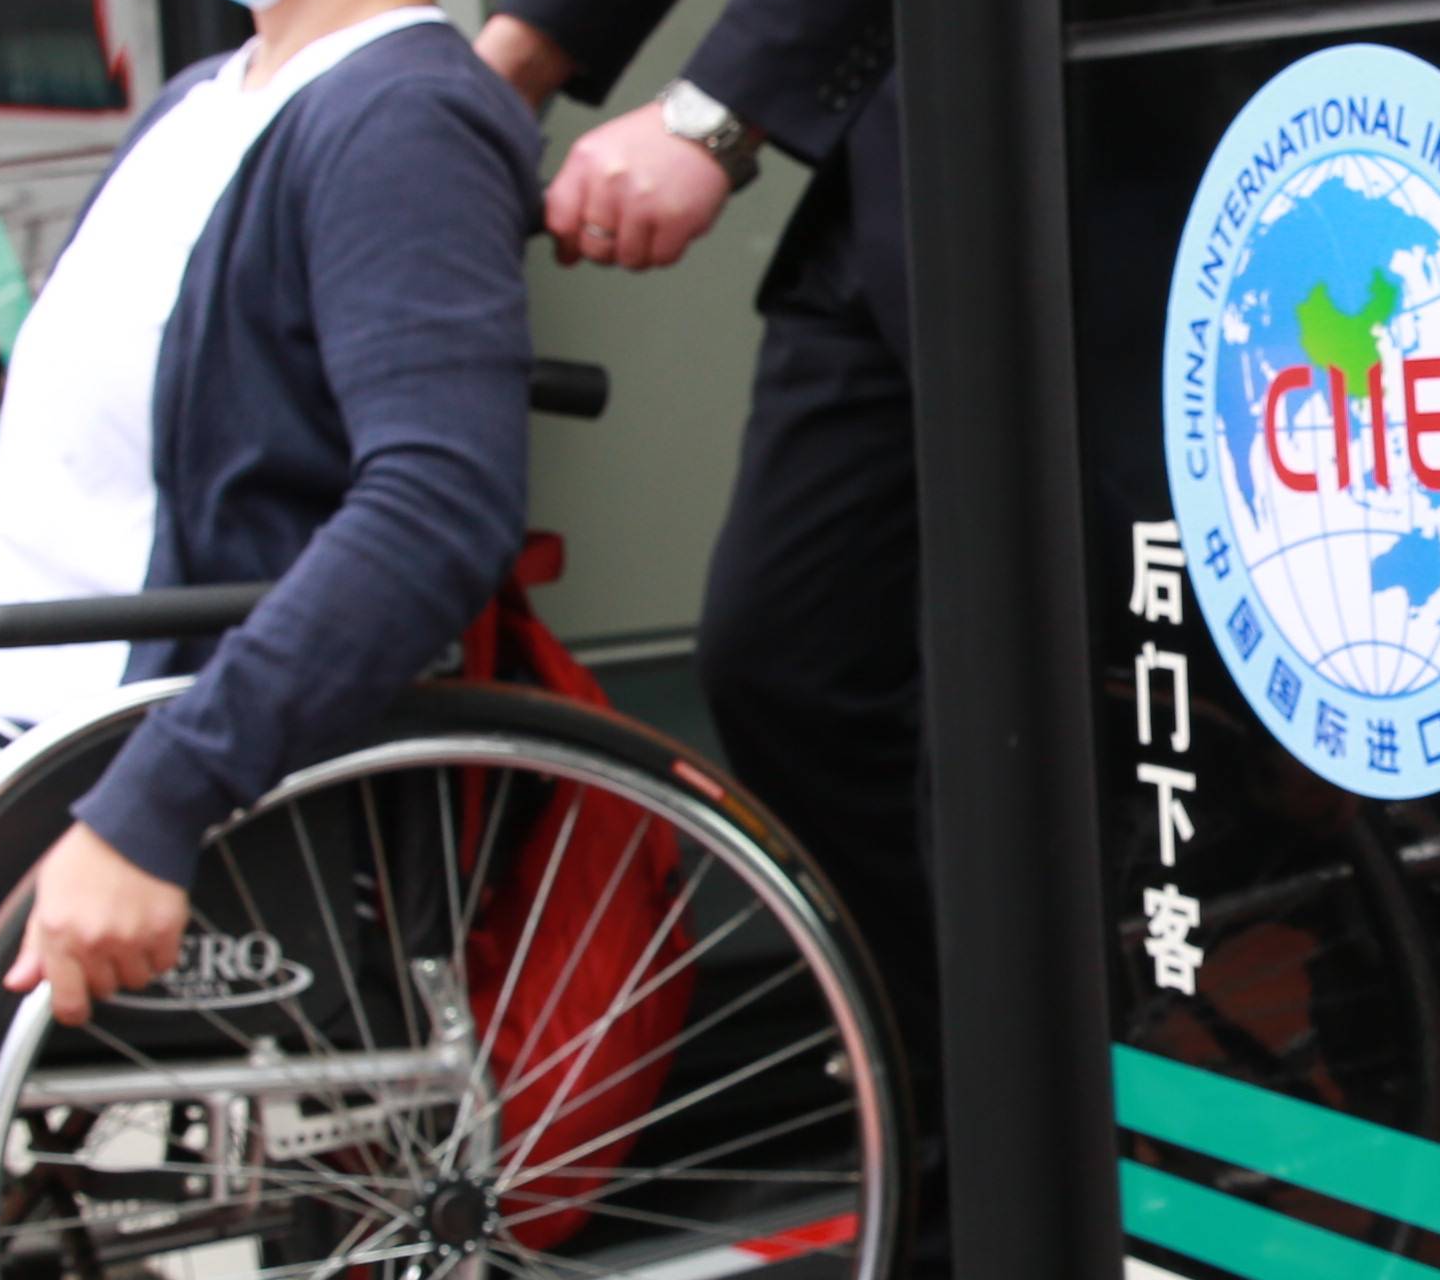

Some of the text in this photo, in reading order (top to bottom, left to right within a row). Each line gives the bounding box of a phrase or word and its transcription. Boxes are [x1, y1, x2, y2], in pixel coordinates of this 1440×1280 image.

[1197, 95, 1411, 300] INTERNATIONAL
[1184, 317, 1212, 480] CHINA
[1129, 519, 1204, 997] 后门下客
